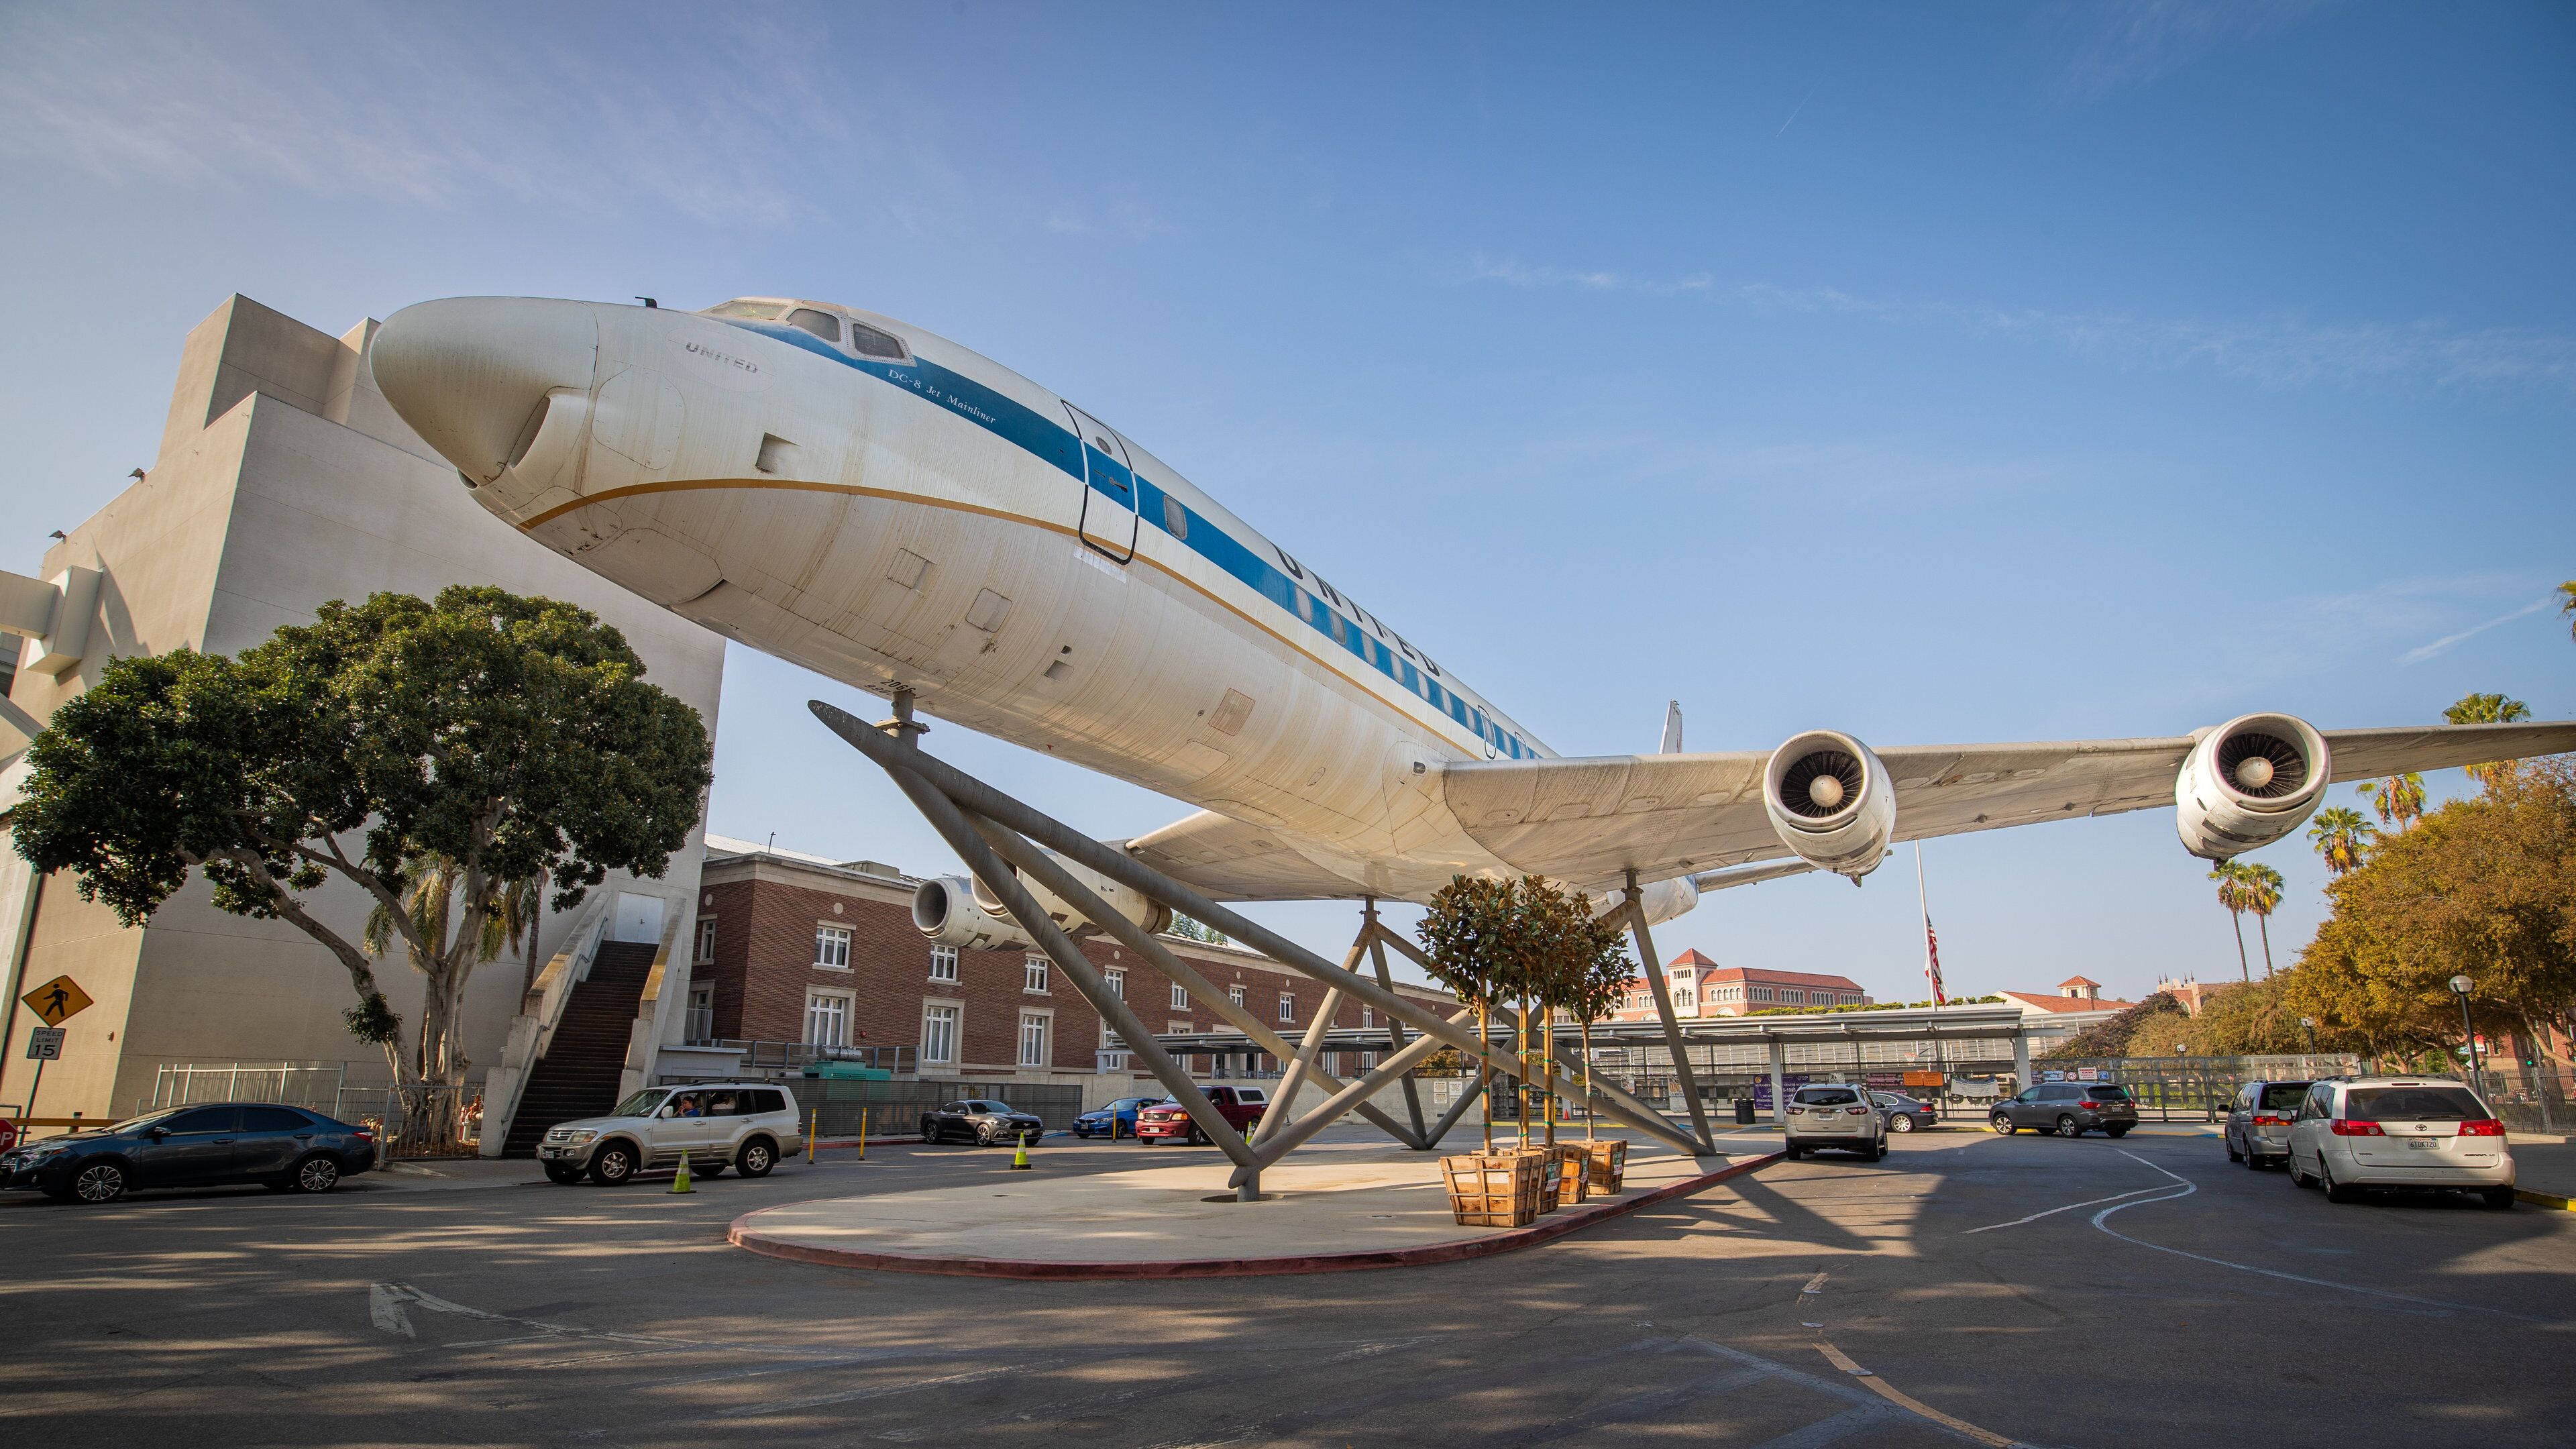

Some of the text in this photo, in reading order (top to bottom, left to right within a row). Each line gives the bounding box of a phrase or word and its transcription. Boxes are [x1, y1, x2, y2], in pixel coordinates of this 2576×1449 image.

[685, 341, 758, 374] UNITED
[888, 369, 996, 424] DC-8 Jet Mainliner
[1271, 541, 1440, 677] UNITED
[35, 1044, 56, 1056] 15
